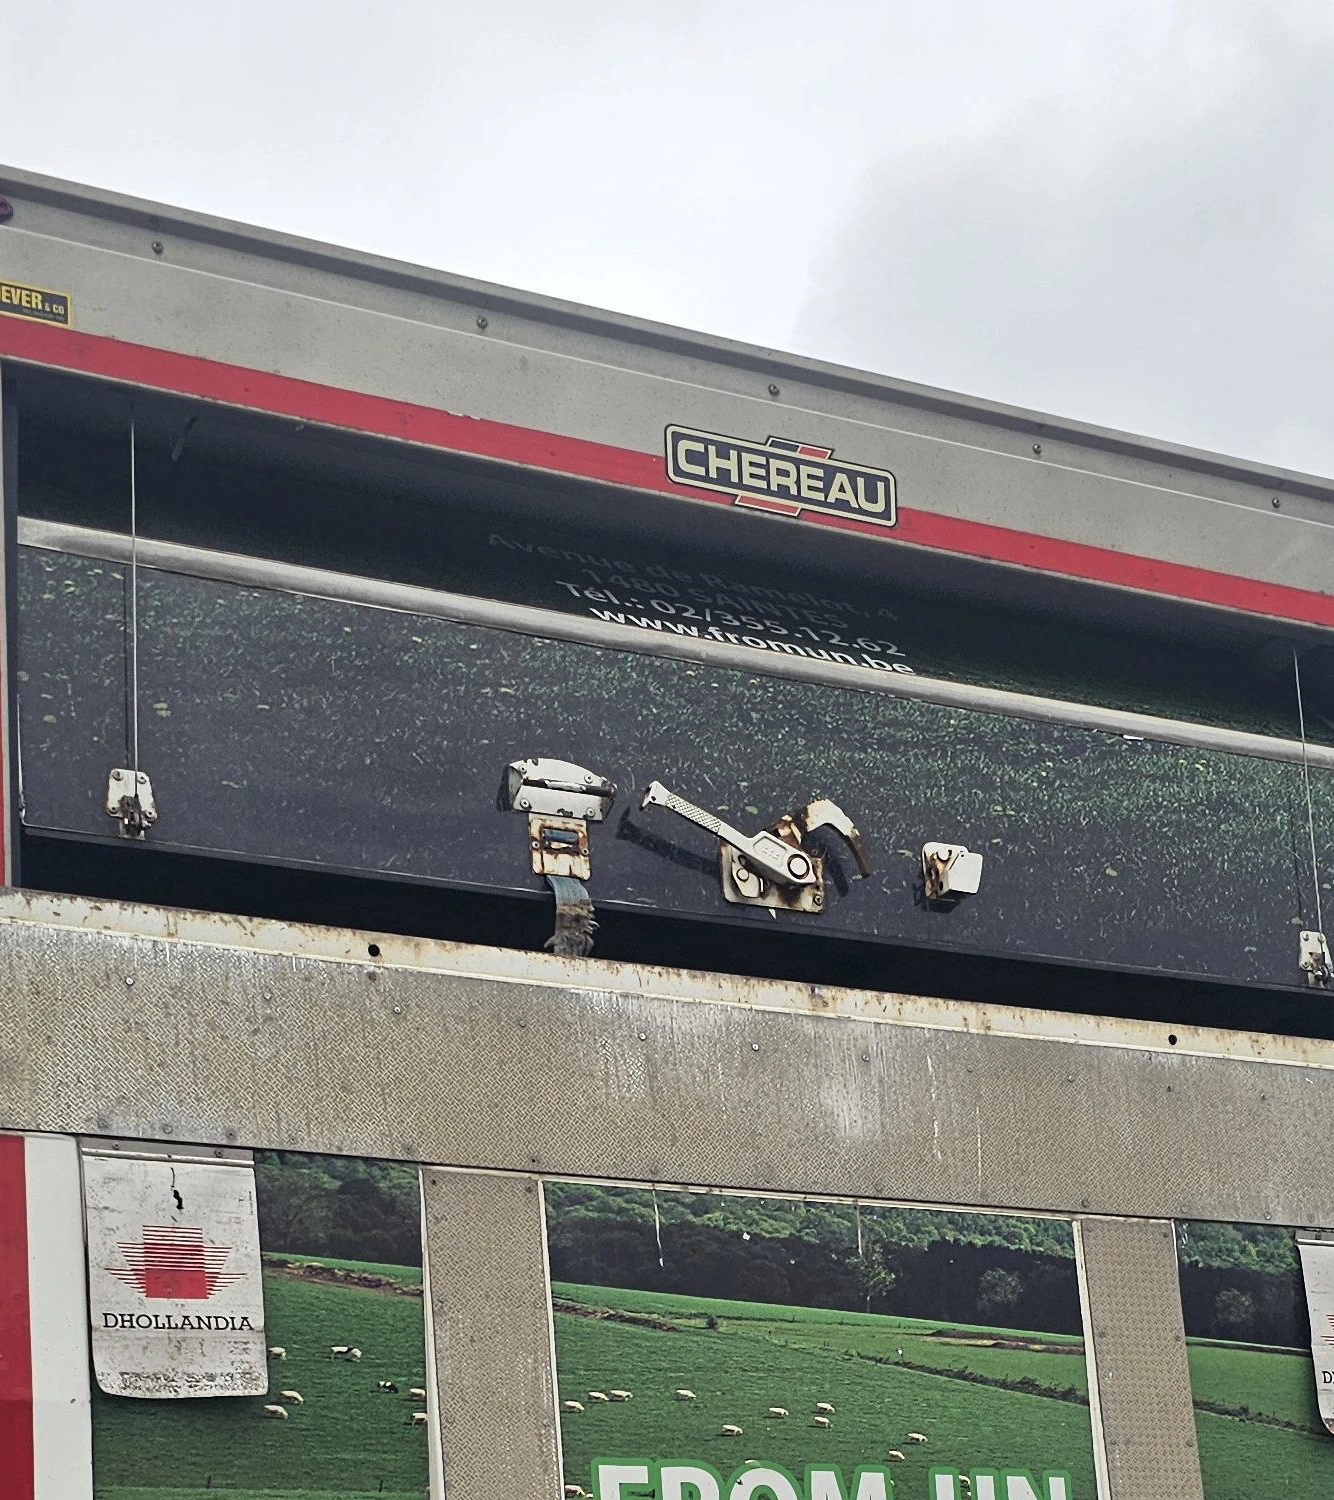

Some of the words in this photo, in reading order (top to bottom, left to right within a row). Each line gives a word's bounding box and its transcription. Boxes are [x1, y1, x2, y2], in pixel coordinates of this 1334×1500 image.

[44, 303, 51, 312] &
[53, 304, 65, 315] CO
[677, 439, 886, 513] CHEREAU
[488, 532, 635, 573] Avenue
[645, 564, 695, 585] de
[556, 580, 644, 610] Tél.:
[652, 599, 906, 658] 02/355.12.62
[581, 569, 681, 598] 1480
[686, 587, 849, 629] SAINTES
[589, 606, 916, 676] www.fromun.be
[102, 1312, 255, 1331] DHOLLANDIA
